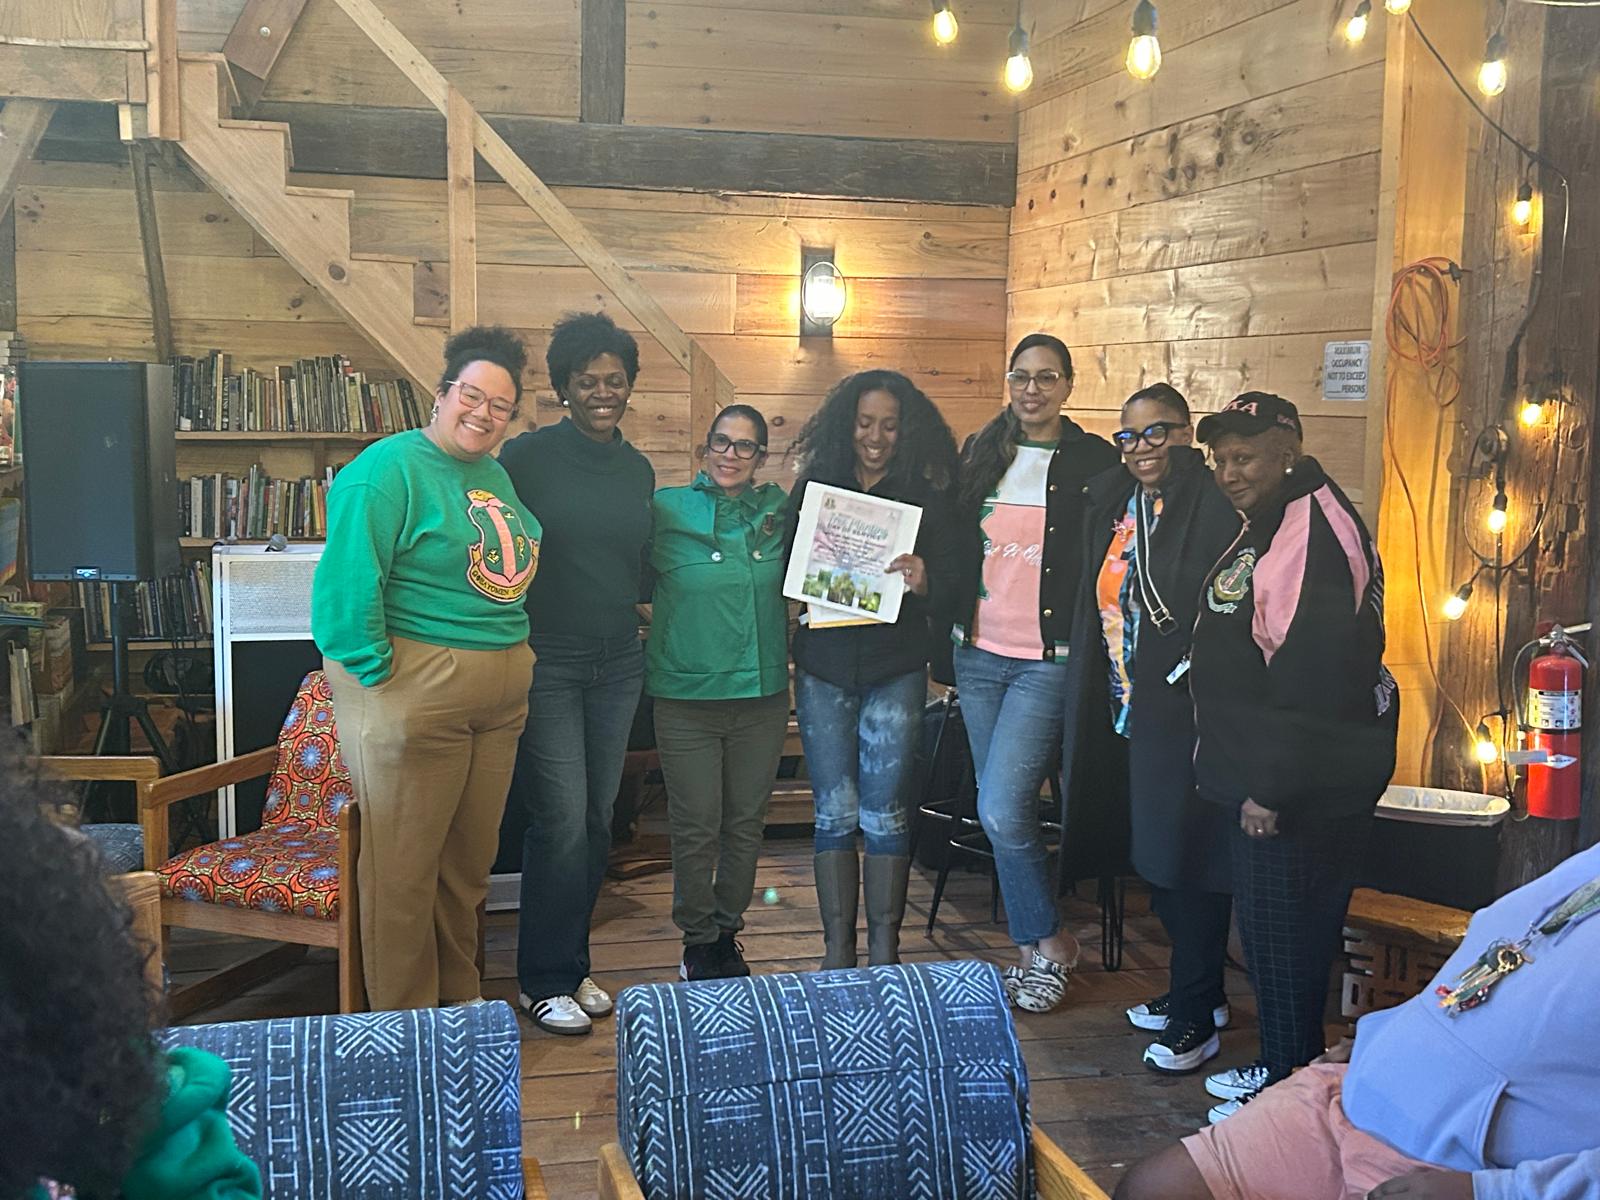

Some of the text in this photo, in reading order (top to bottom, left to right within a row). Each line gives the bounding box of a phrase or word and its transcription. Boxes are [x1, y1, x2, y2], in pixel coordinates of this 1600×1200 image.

[1331, 358, 1362, 368] OCCUPANCY
[1346, 371, 1366, 381] EXCEED
[1341, 384, 1366, 393] PERSONS
